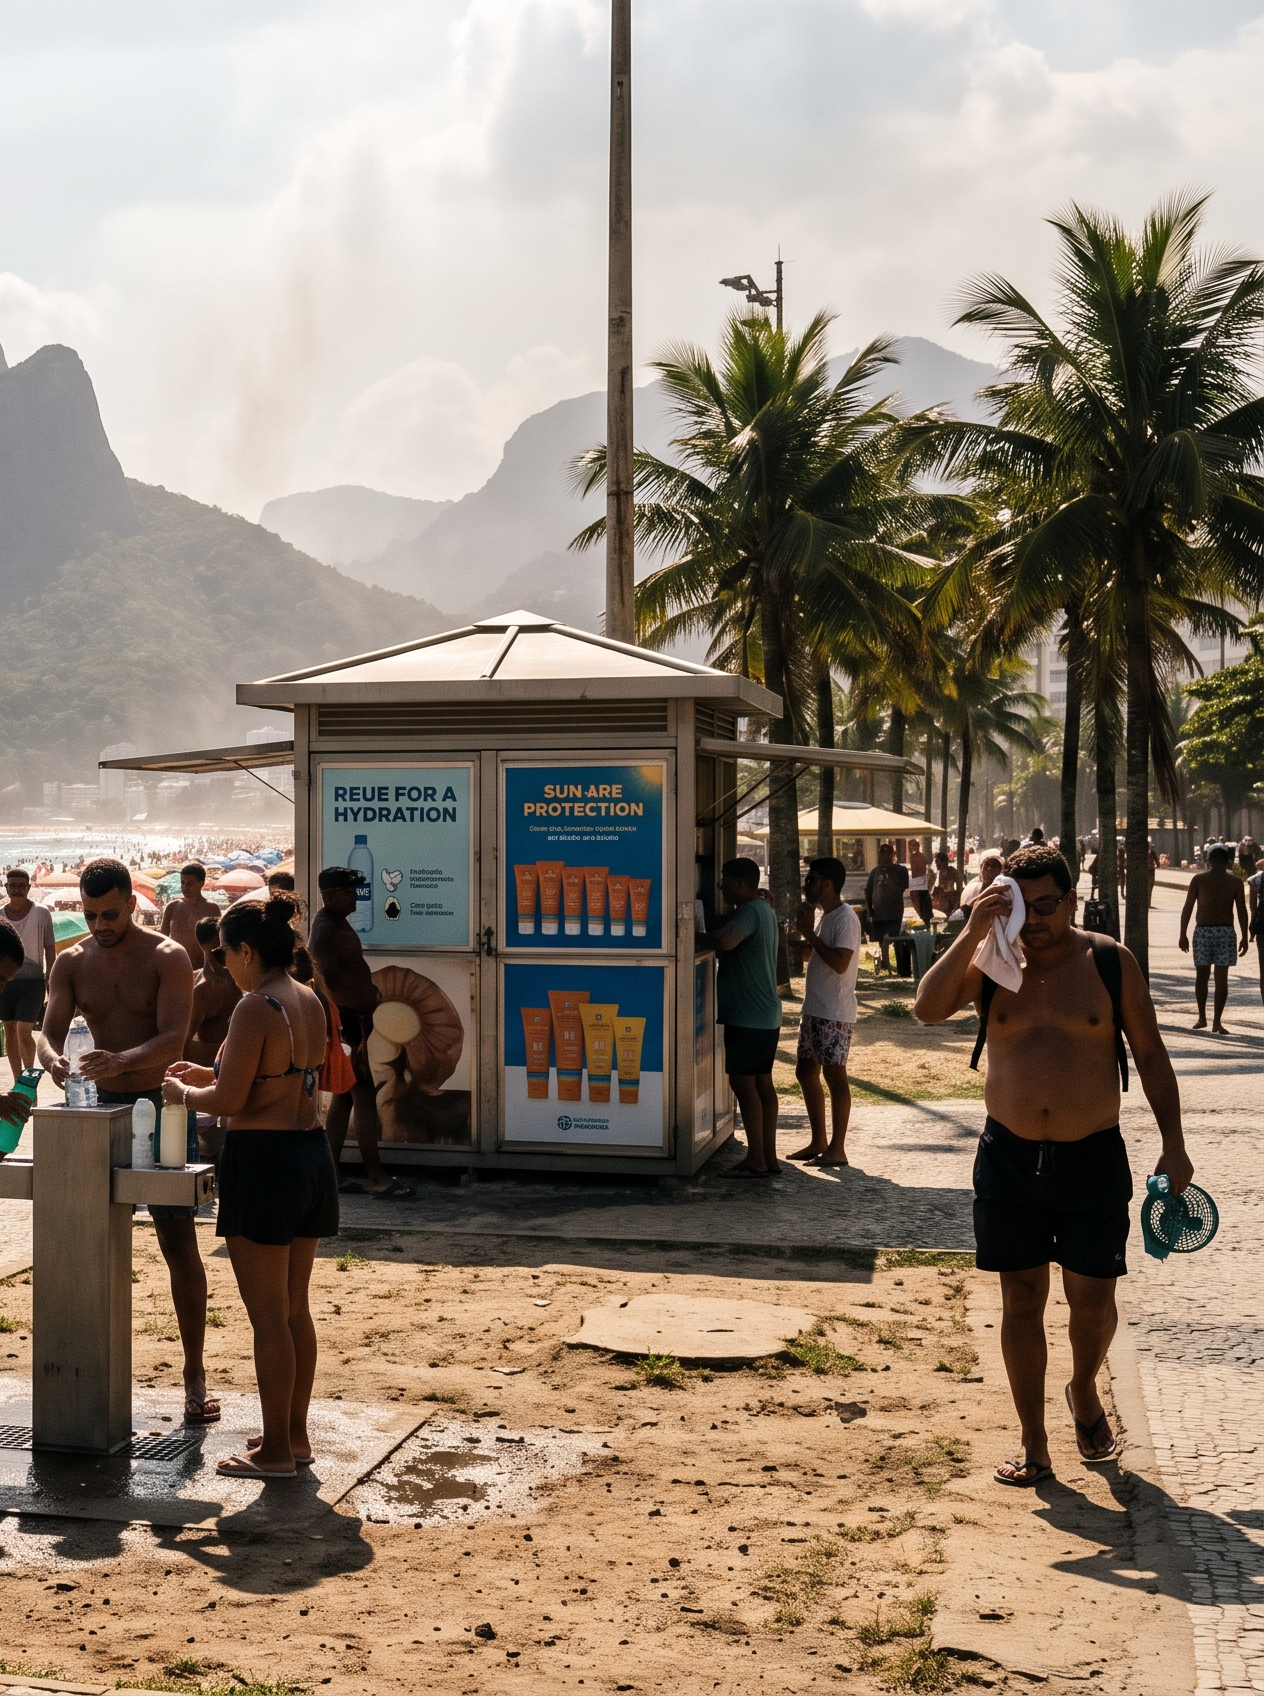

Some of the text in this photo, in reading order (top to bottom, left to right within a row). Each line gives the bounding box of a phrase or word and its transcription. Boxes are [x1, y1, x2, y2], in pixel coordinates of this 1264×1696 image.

[334, 785, 458, 803] REUE FOR A
[544, 784, 583, 798] SUN
[334, 806, 457, 823] HYDRATION
[523, 802, 644, 817] PROTECTION
